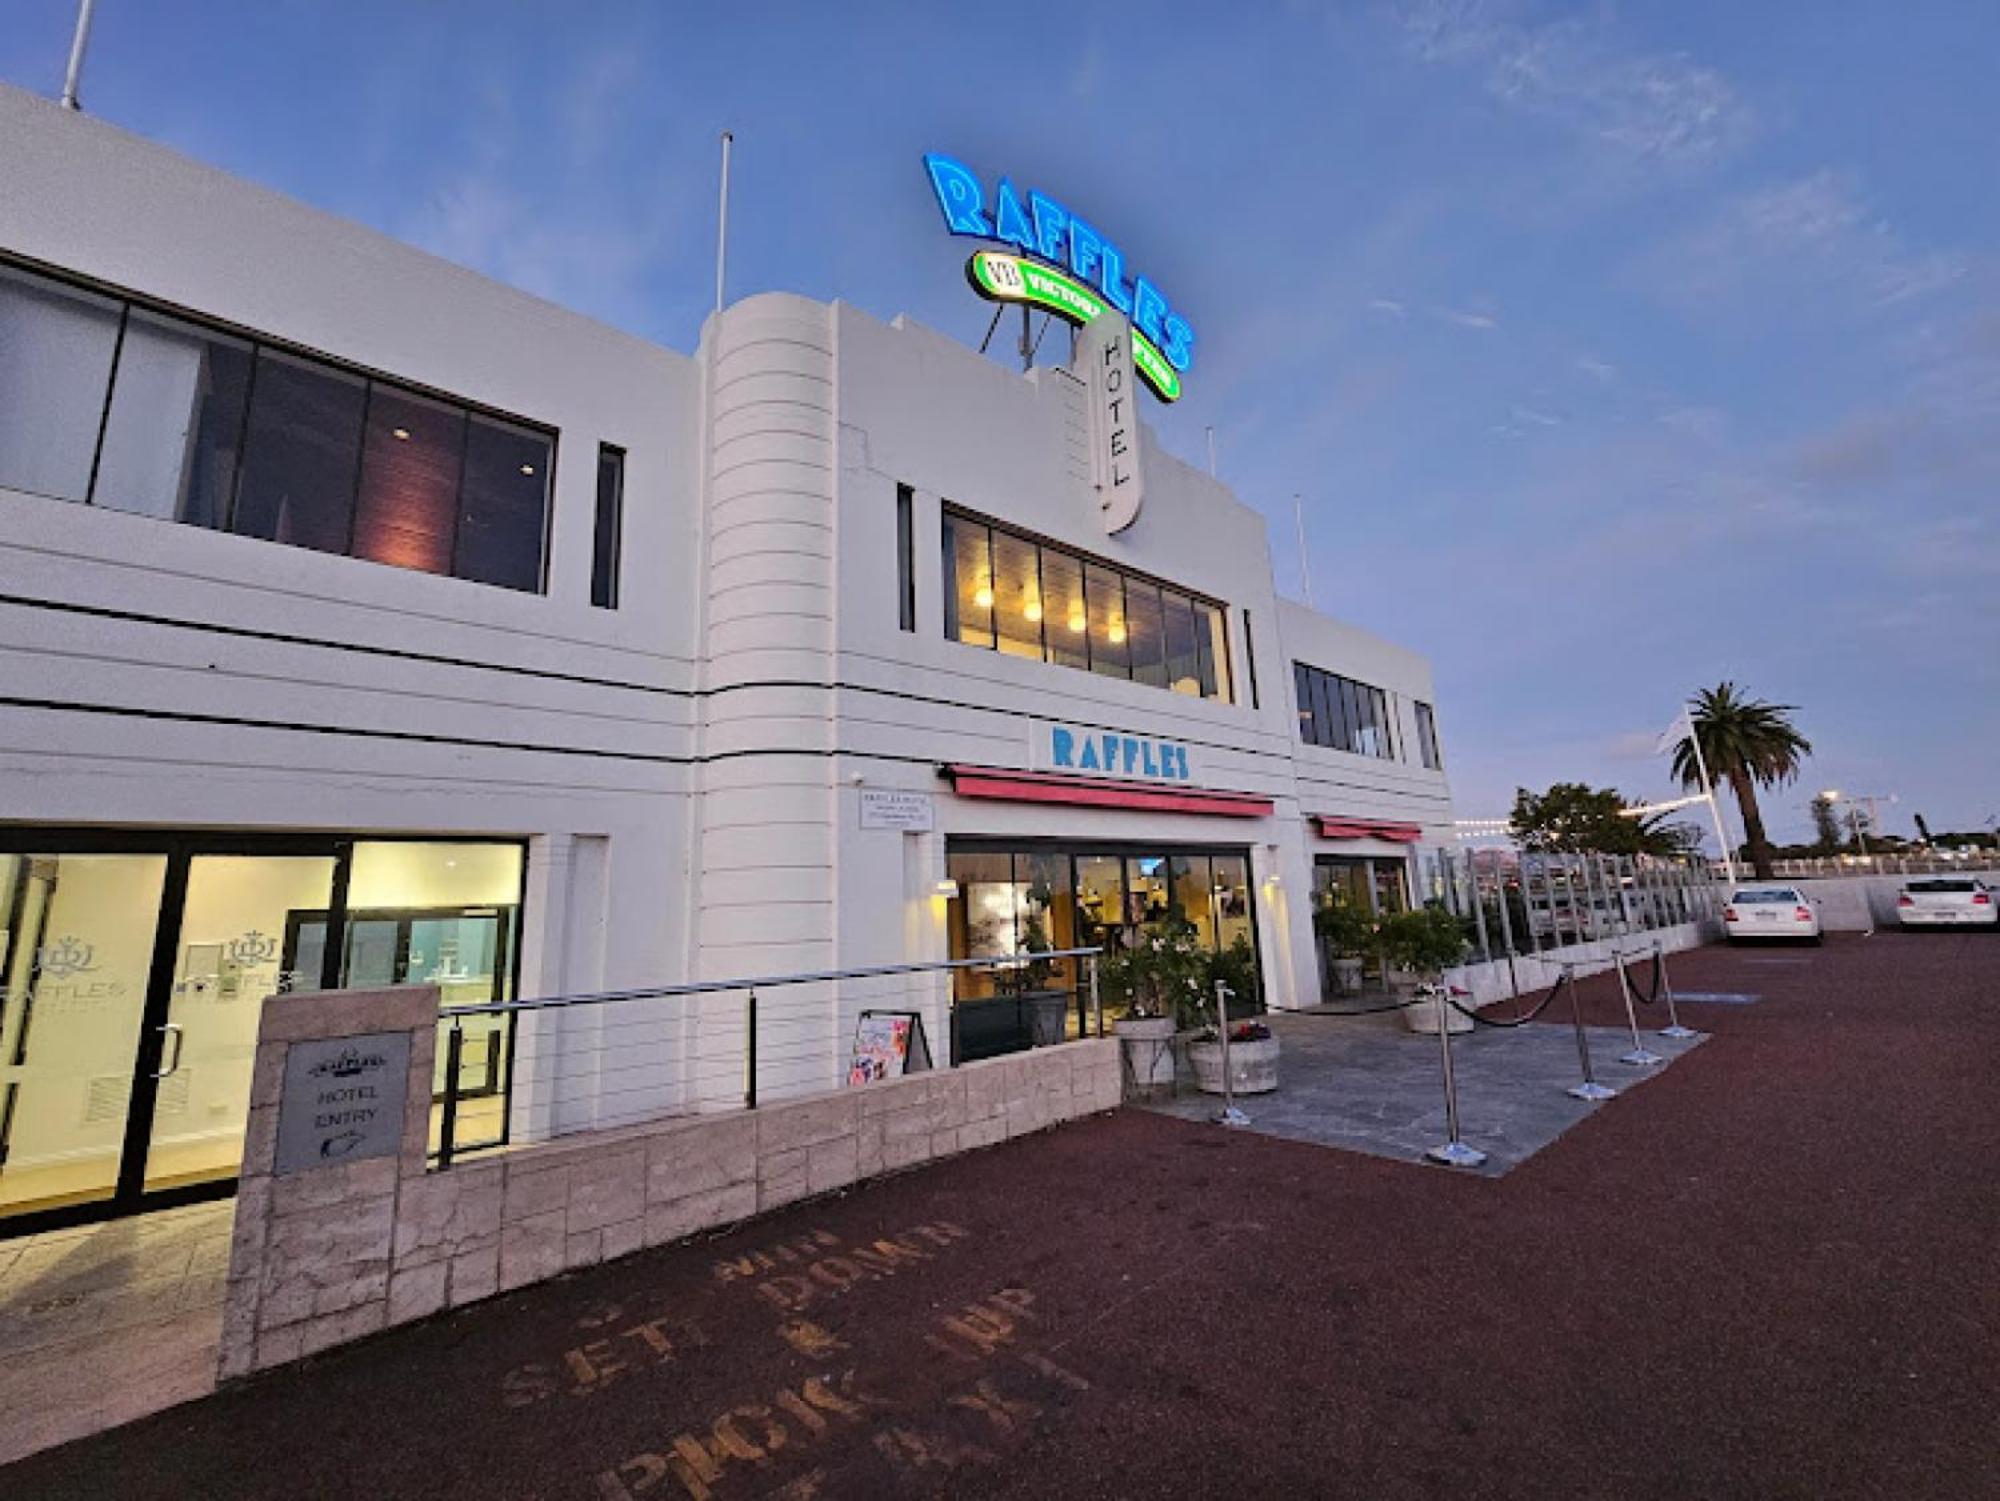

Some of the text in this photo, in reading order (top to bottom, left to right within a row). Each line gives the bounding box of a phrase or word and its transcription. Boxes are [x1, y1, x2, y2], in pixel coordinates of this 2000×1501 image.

[922, 152, 1194, 374] RAFFLES
[1103, 336, 1131, 488] HOTEL
[1052, 726, 1190, 781] RAFFLES
[314, 1107, 379, 1129] ENTRY
[317, 1086, 379, 1106] HOTEL
